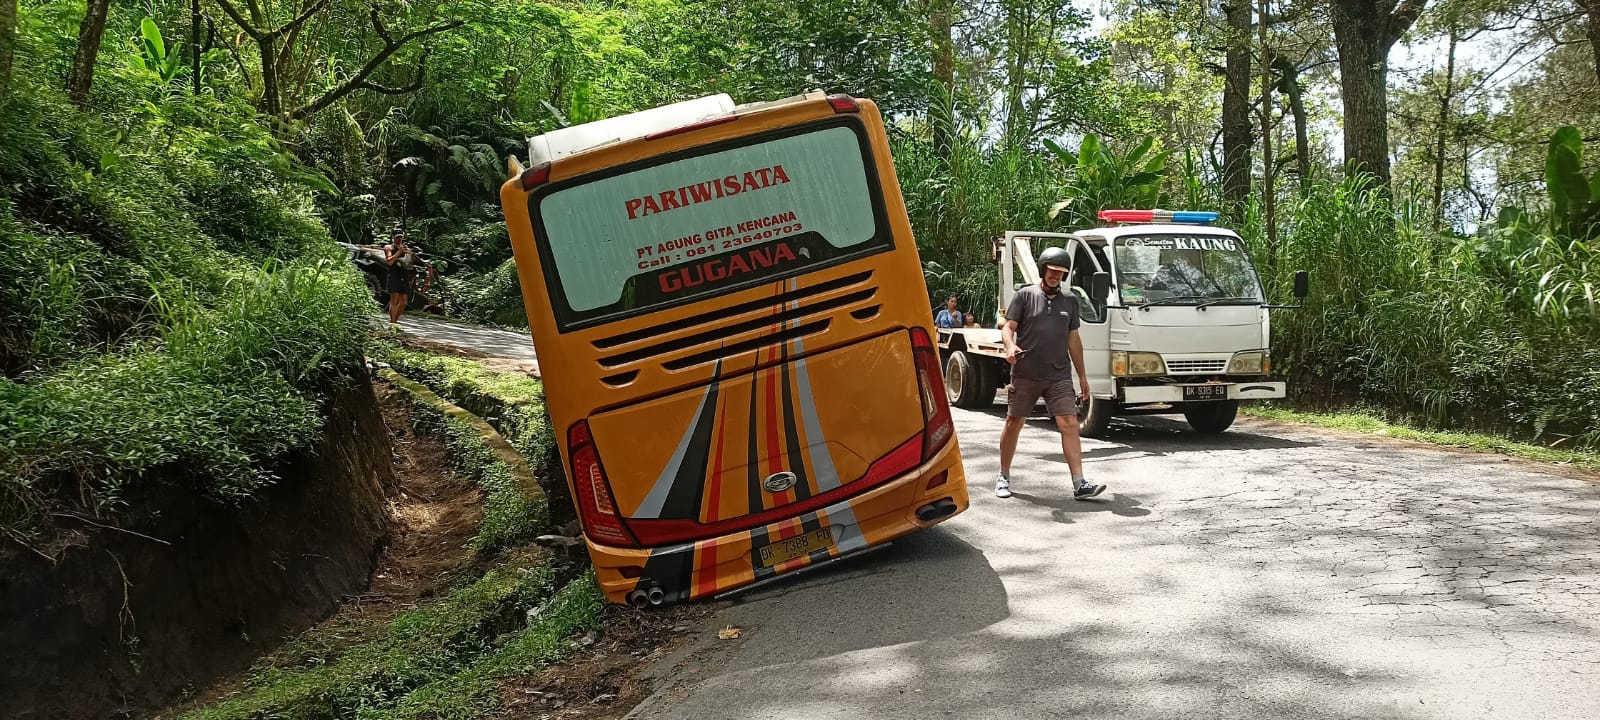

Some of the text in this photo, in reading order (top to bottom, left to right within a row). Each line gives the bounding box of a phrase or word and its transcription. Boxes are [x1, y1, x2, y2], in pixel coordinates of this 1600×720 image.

[625, 165, 790, 220] PARIWISATA
[637, 211, 797, 259] PT AGUNG GITA KENCANA
[637, 256, 670, 270] Call
[686, 246, 715, 257] 081
[723, 223, 803, 248] 23640703
[1174, 237, 1236, 251] KAUNG
[658, 242, 796, 293] GUGANA
[1186, 386, 1195, 396] DK
[761, 547, 775, 561] DK
